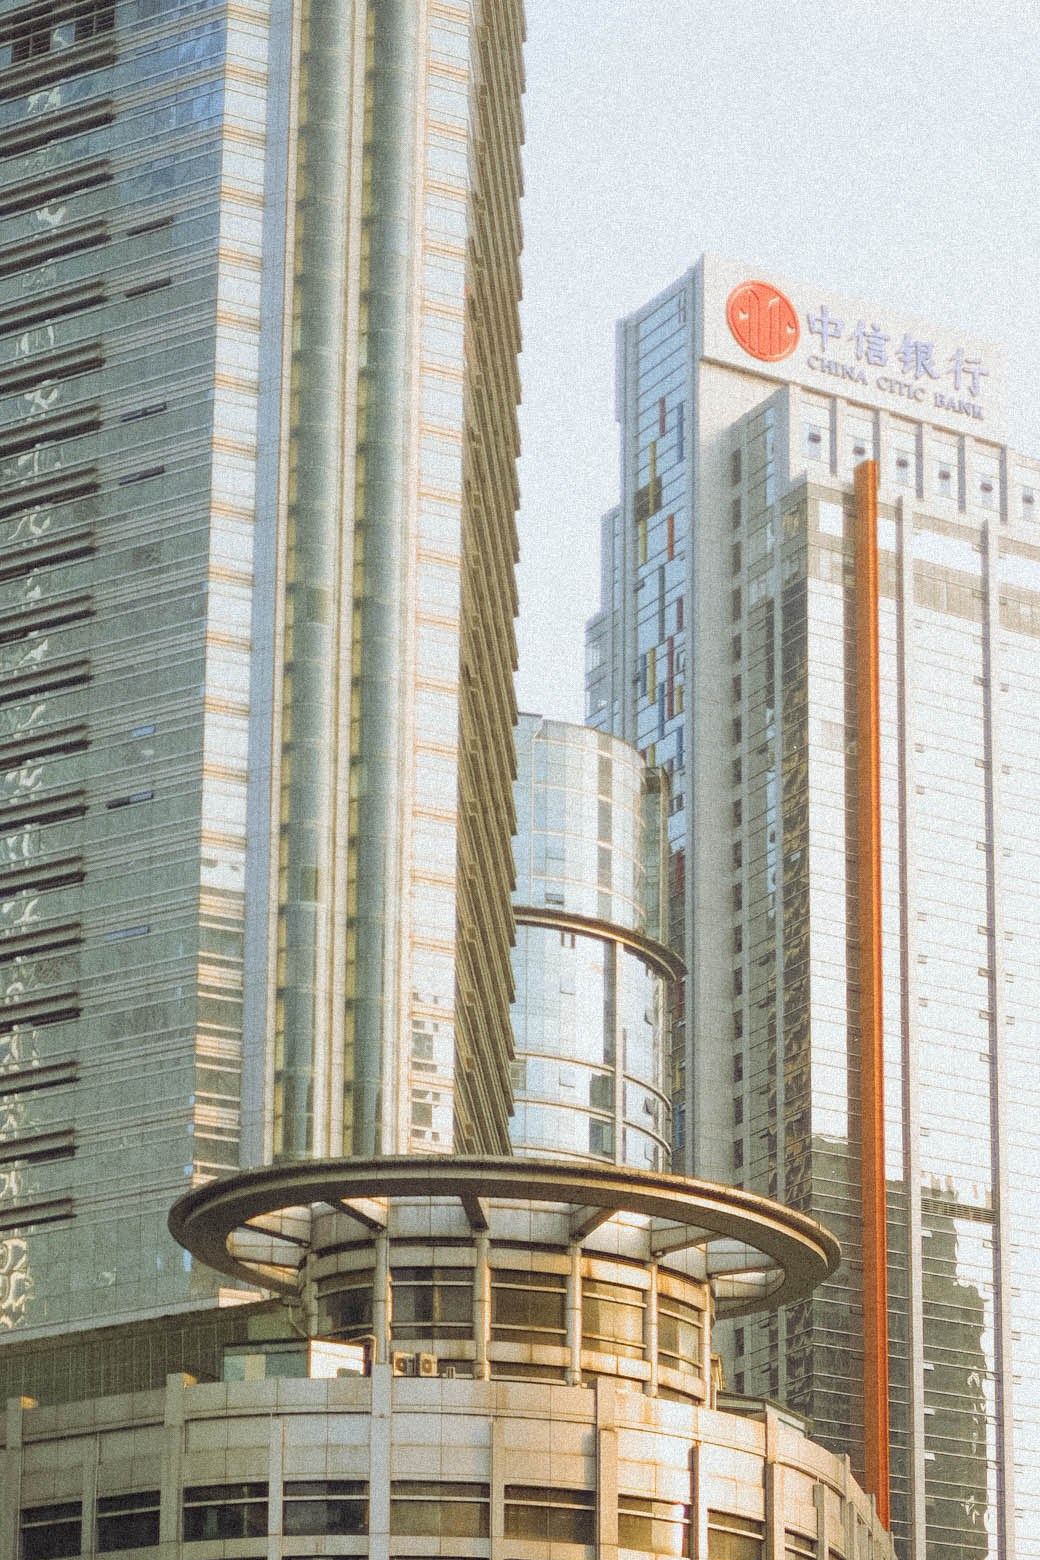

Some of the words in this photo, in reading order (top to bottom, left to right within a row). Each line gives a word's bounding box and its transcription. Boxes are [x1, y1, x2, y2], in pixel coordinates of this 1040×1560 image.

[806, 304, 990, 398] 中信银行
[807, 354, 868, 386] CHINA
[876, 375, 927, 402] CITIC
[934, 392, 985, 421] BANK
